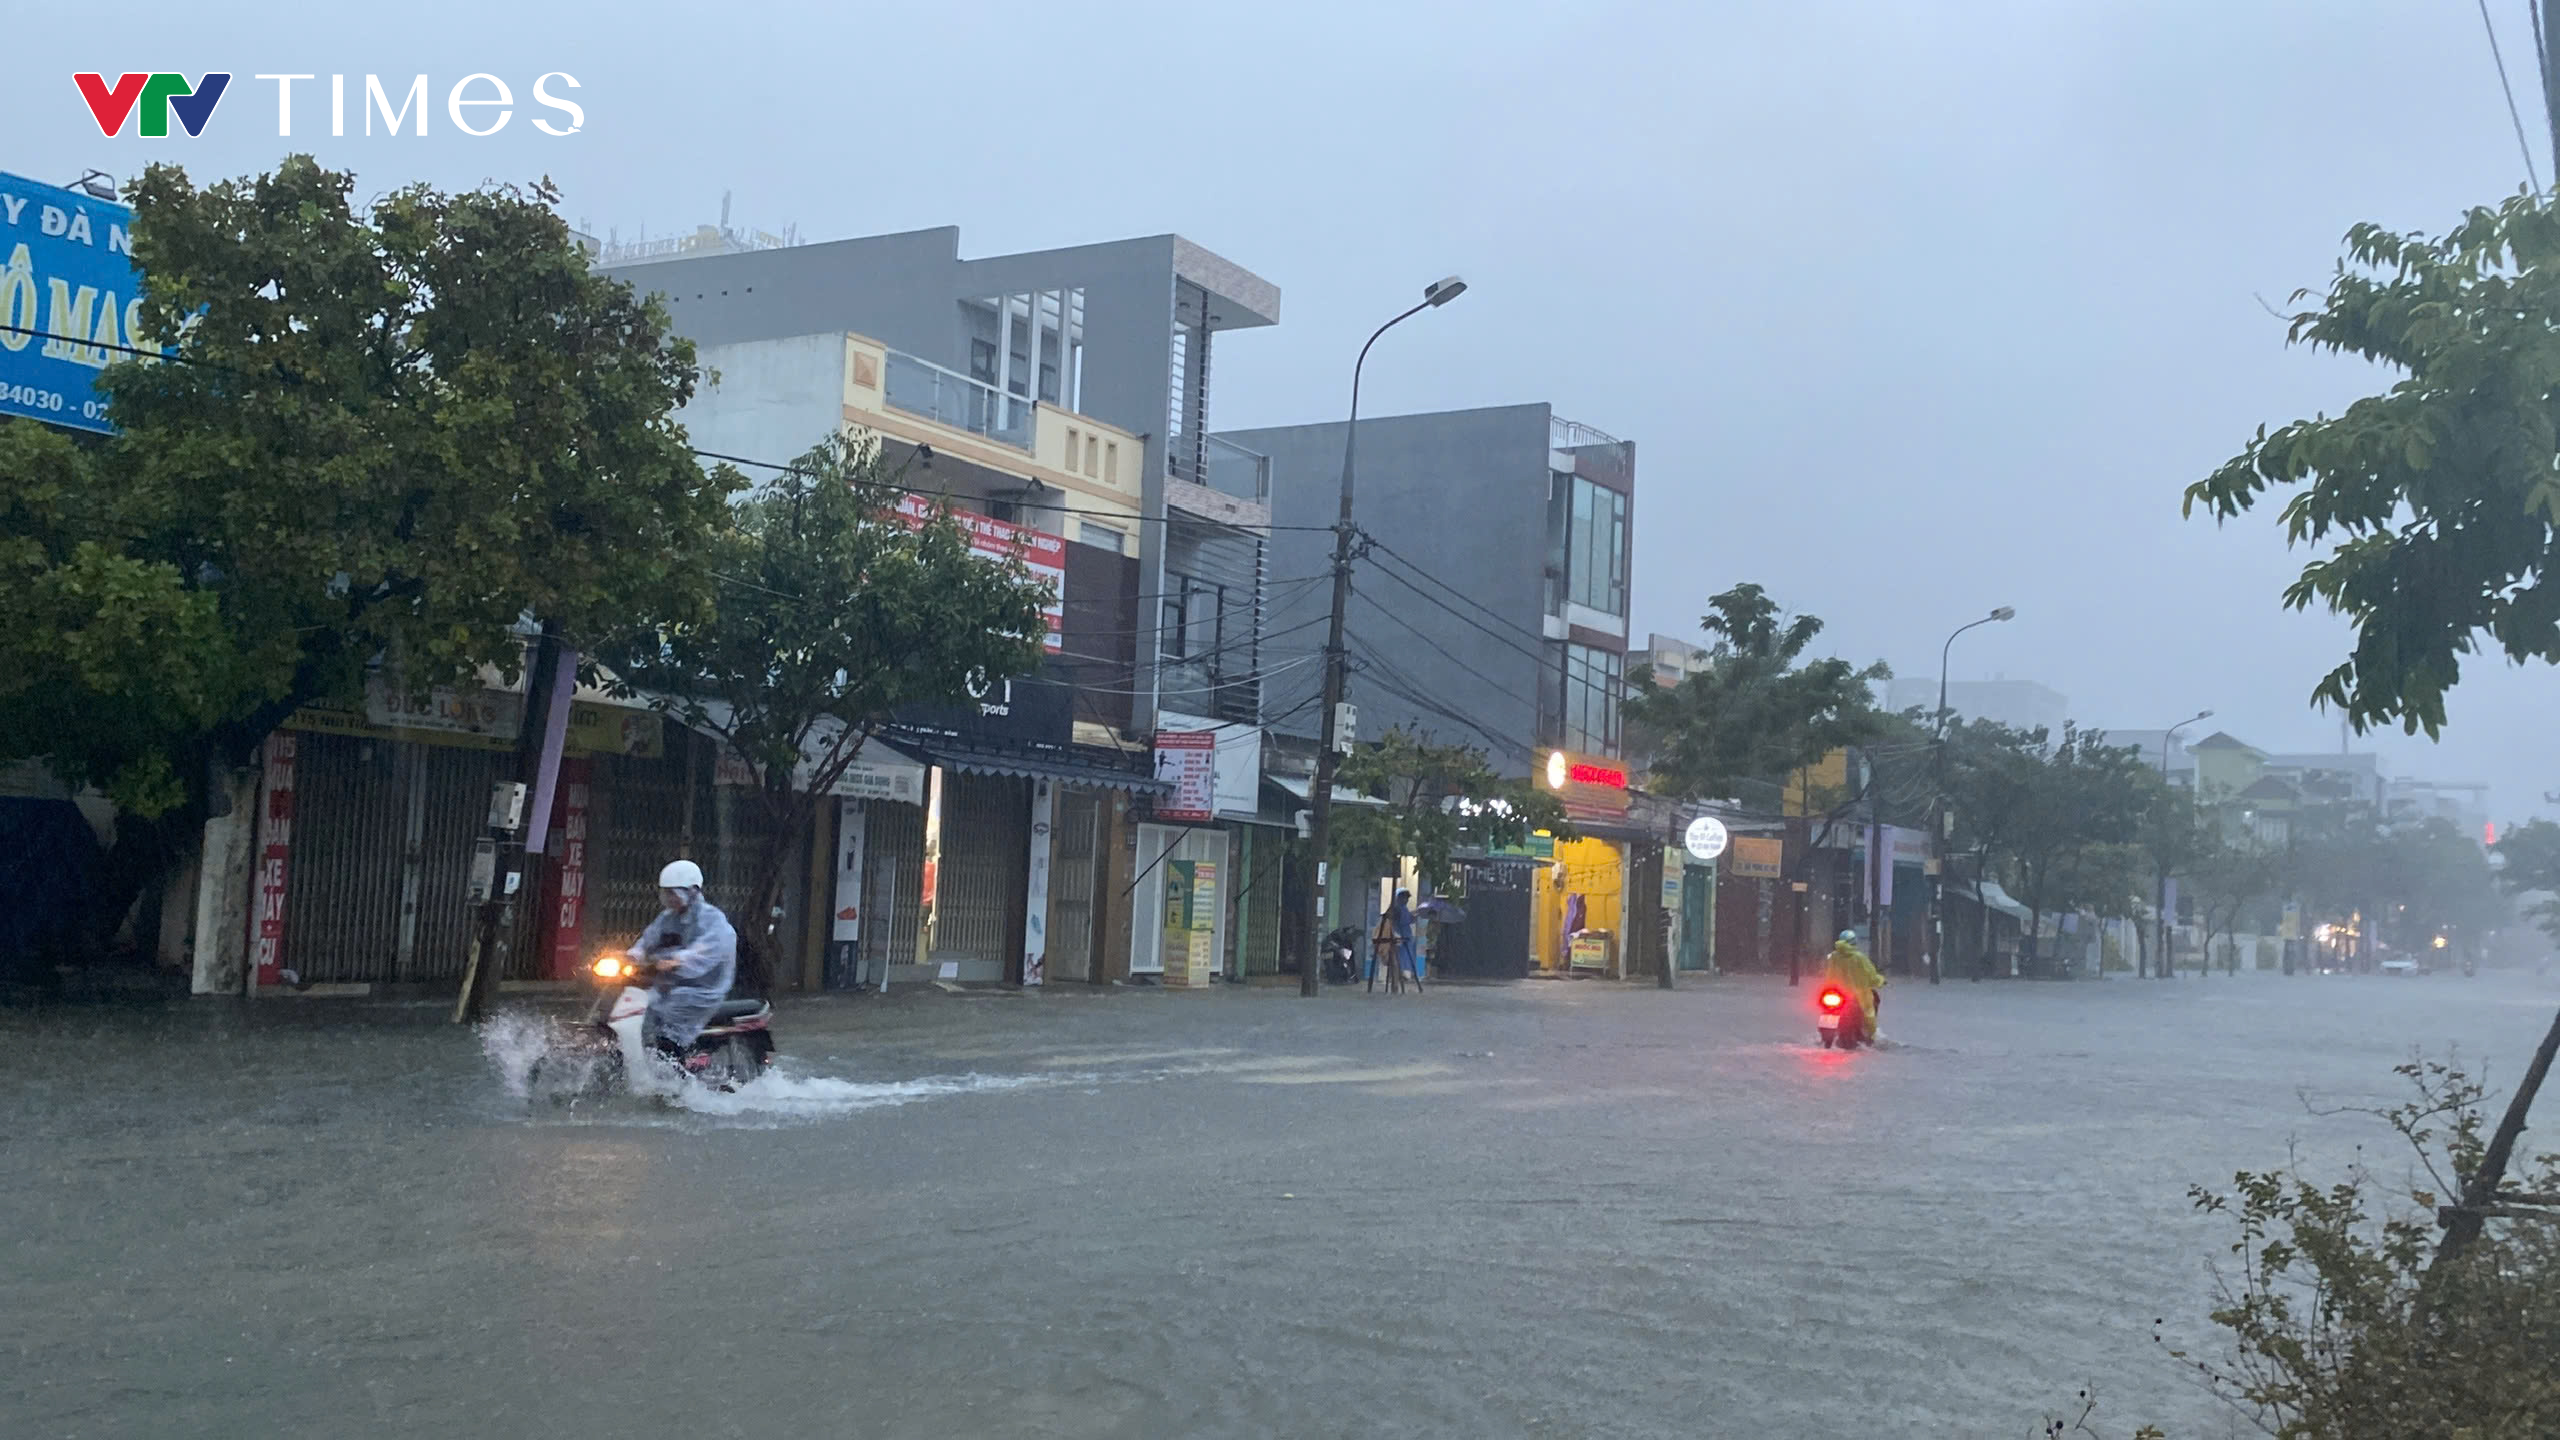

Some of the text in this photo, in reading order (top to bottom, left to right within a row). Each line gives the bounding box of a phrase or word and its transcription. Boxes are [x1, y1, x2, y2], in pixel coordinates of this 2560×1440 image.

[41, 205, 93, 246] ĐÀ
[976, 703, 1009, 717] ports
[568, 842, 583, 866] XE
[264, 858, 283, 887] XE
